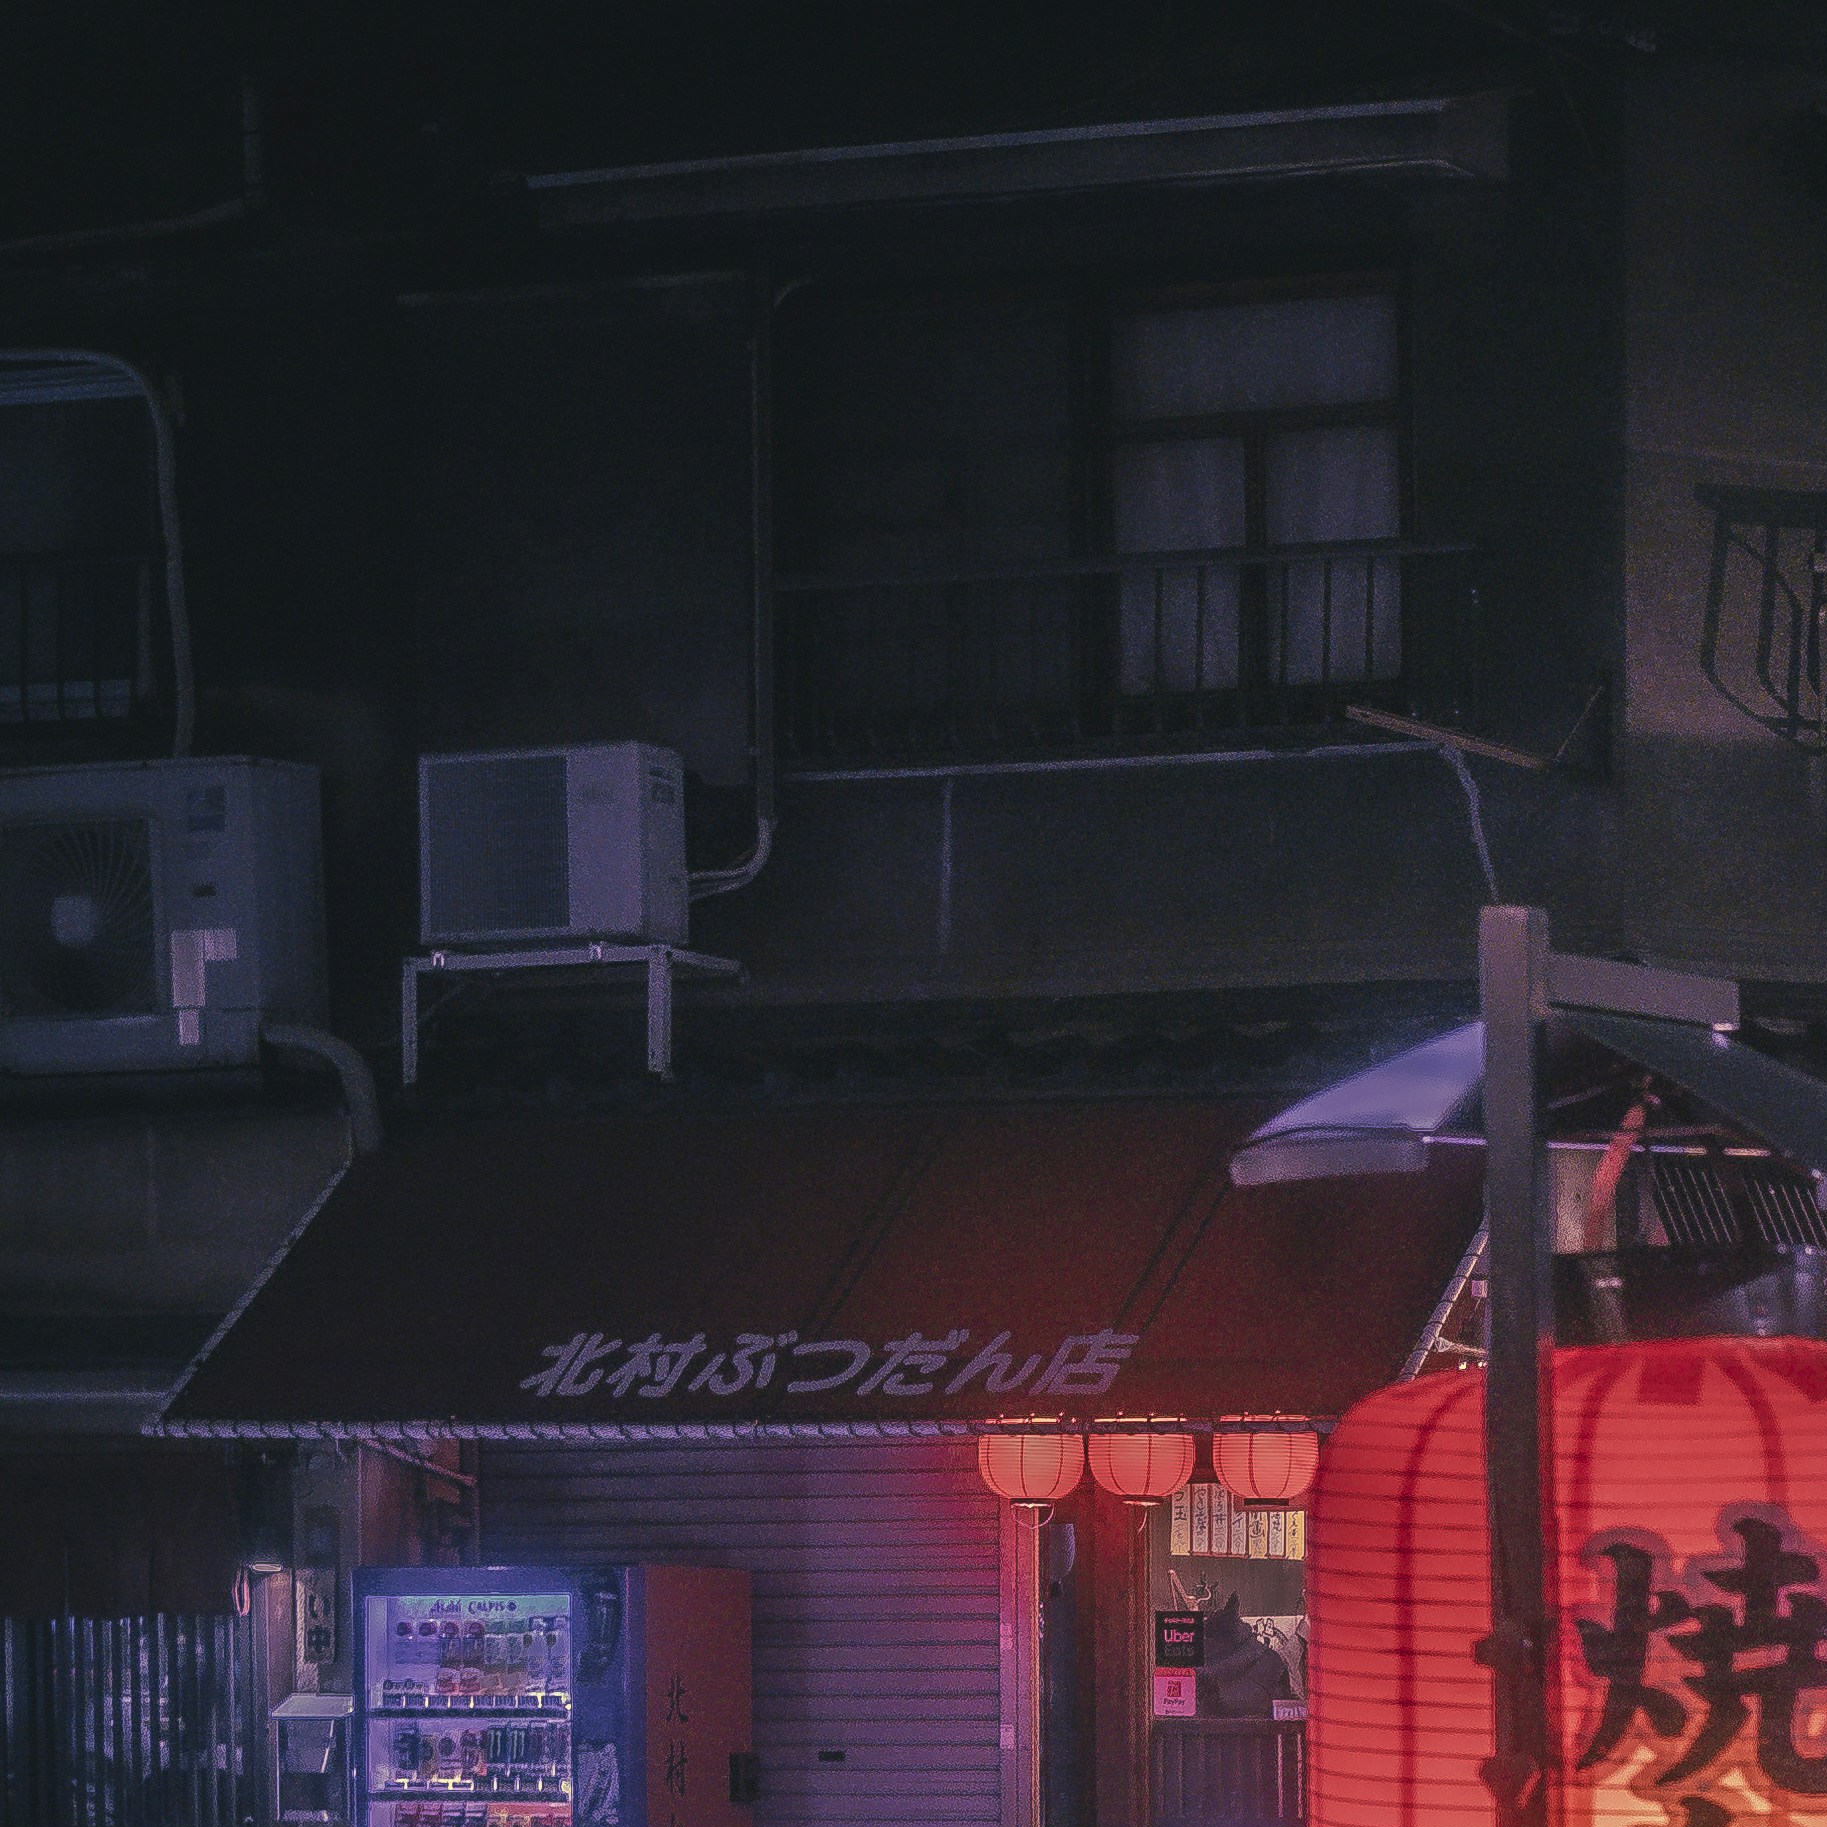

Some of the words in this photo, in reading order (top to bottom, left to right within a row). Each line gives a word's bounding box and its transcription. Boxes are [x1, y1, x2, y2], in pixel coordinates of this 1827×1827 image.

[520, 1330, 1140, 1397] 北村ぶつだん店
[1163, 1629, 1195, 1643] Uber
